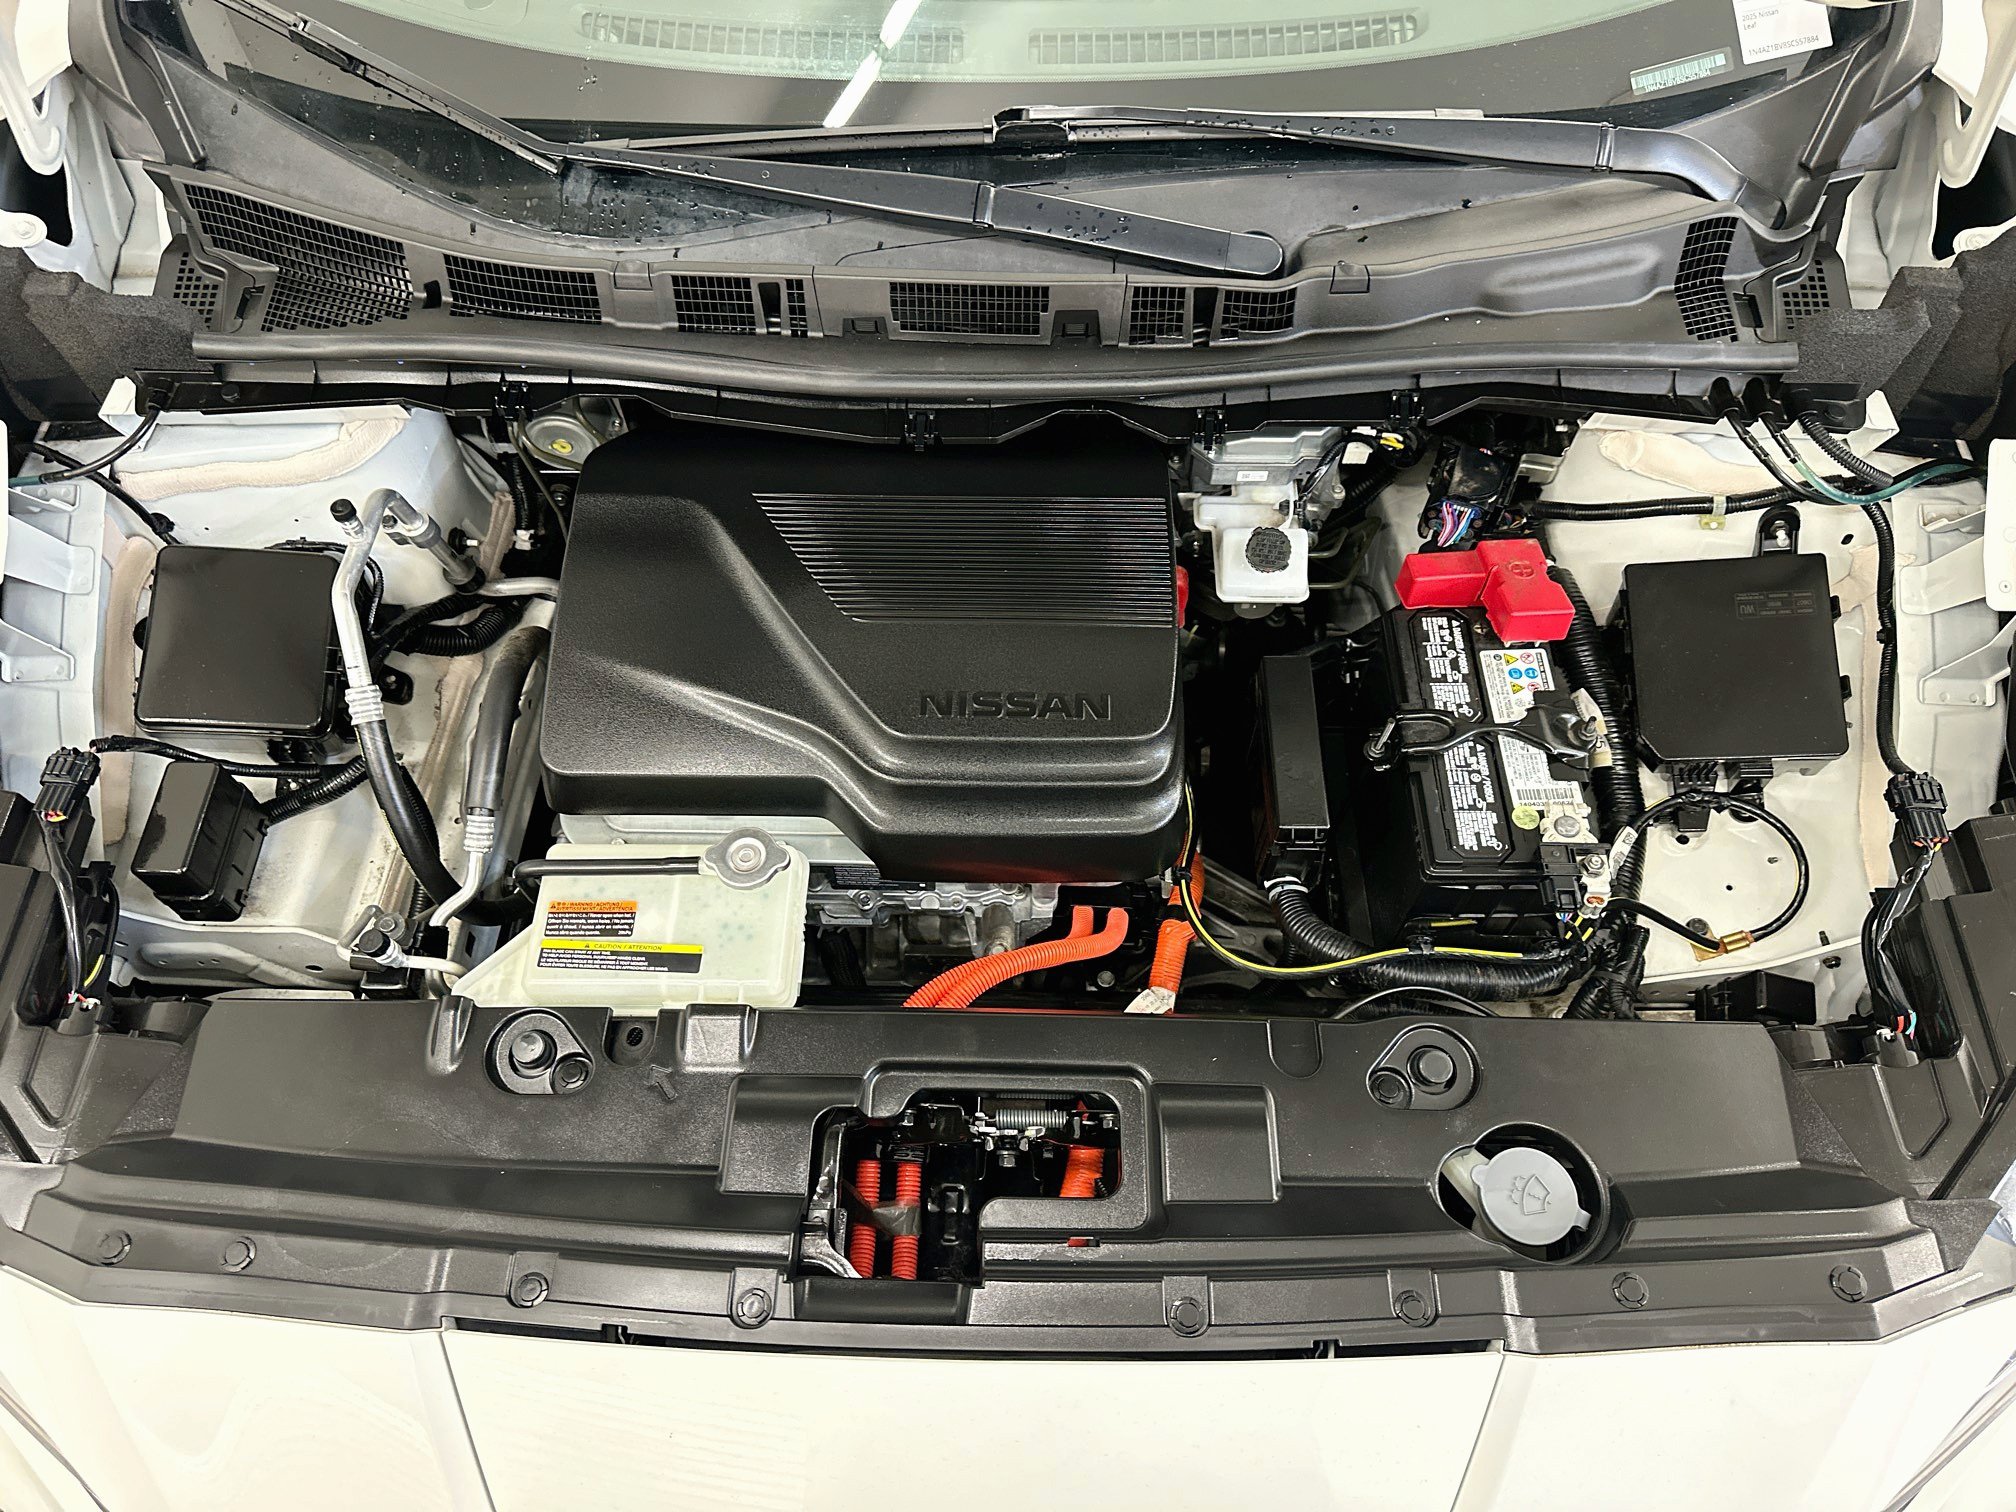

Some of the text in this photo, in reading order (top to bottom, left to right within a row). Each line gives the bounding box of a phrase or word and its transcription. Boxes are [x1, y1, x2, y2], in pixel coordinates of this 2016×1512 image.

[1758, 9, 1779, 17] Nissan
[1743, 21, 1757, 30] Leaf
[919, 690, 1111, 720] NISSAN
